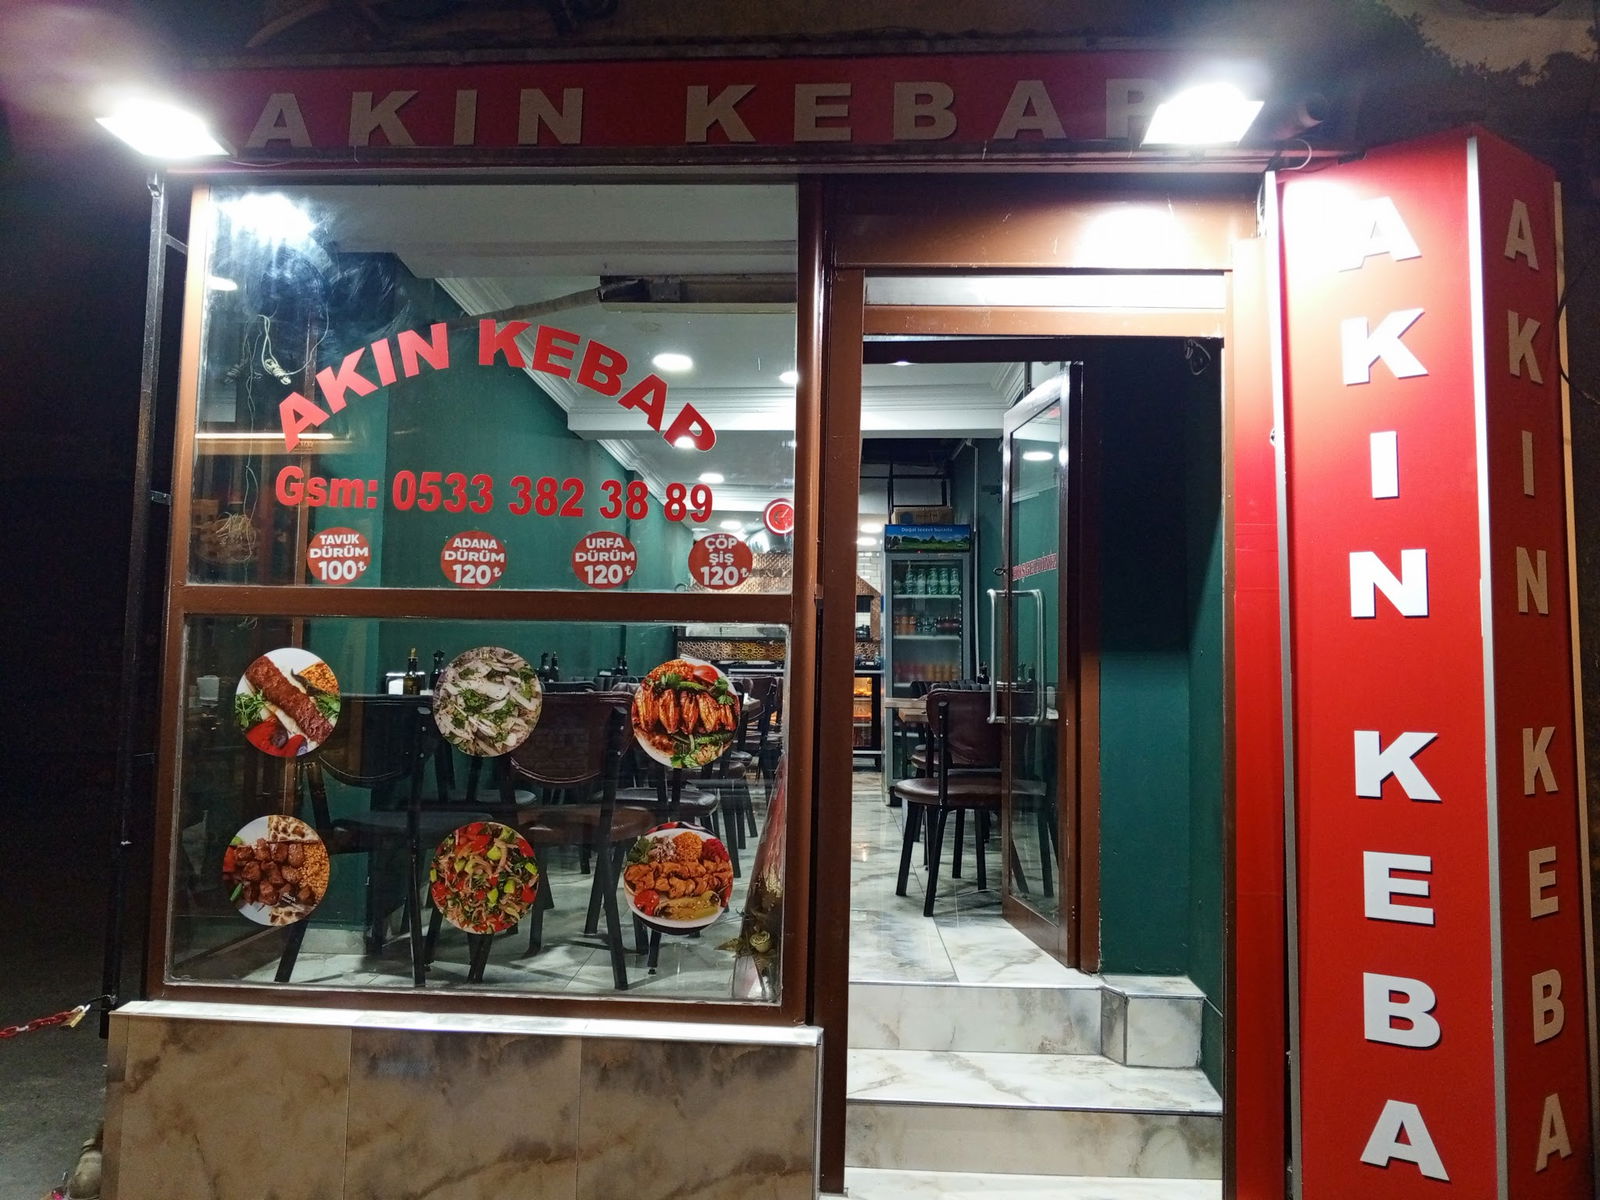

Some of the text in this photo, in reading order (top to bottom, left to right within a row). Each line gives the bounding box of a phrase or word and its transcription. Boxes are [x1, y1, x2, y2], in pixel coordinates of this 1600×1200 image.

[245, 87, 584, 148] AKIN
[278, 319, 717, 452] AKIN KEBAP
[275, 465, 714, 523] Gsm: 0533 382 38 89
[319, 534, 360, 545] TAVUK
[453, 537, 498, 549] ADANA
[585, 537, 625, 549] URFA
[704, 535, 737, 552] ÇÖP
[310, 545, 369, 558] DÜRÜM
[444, 549, 505, 562] DÜRÜM
[575, 549, 635, 562] DÜRÜM
[1337, 196, 1450, 1182] AKIN KEBA
[1504, 200, 1573, 1174] AKIN KEBA
